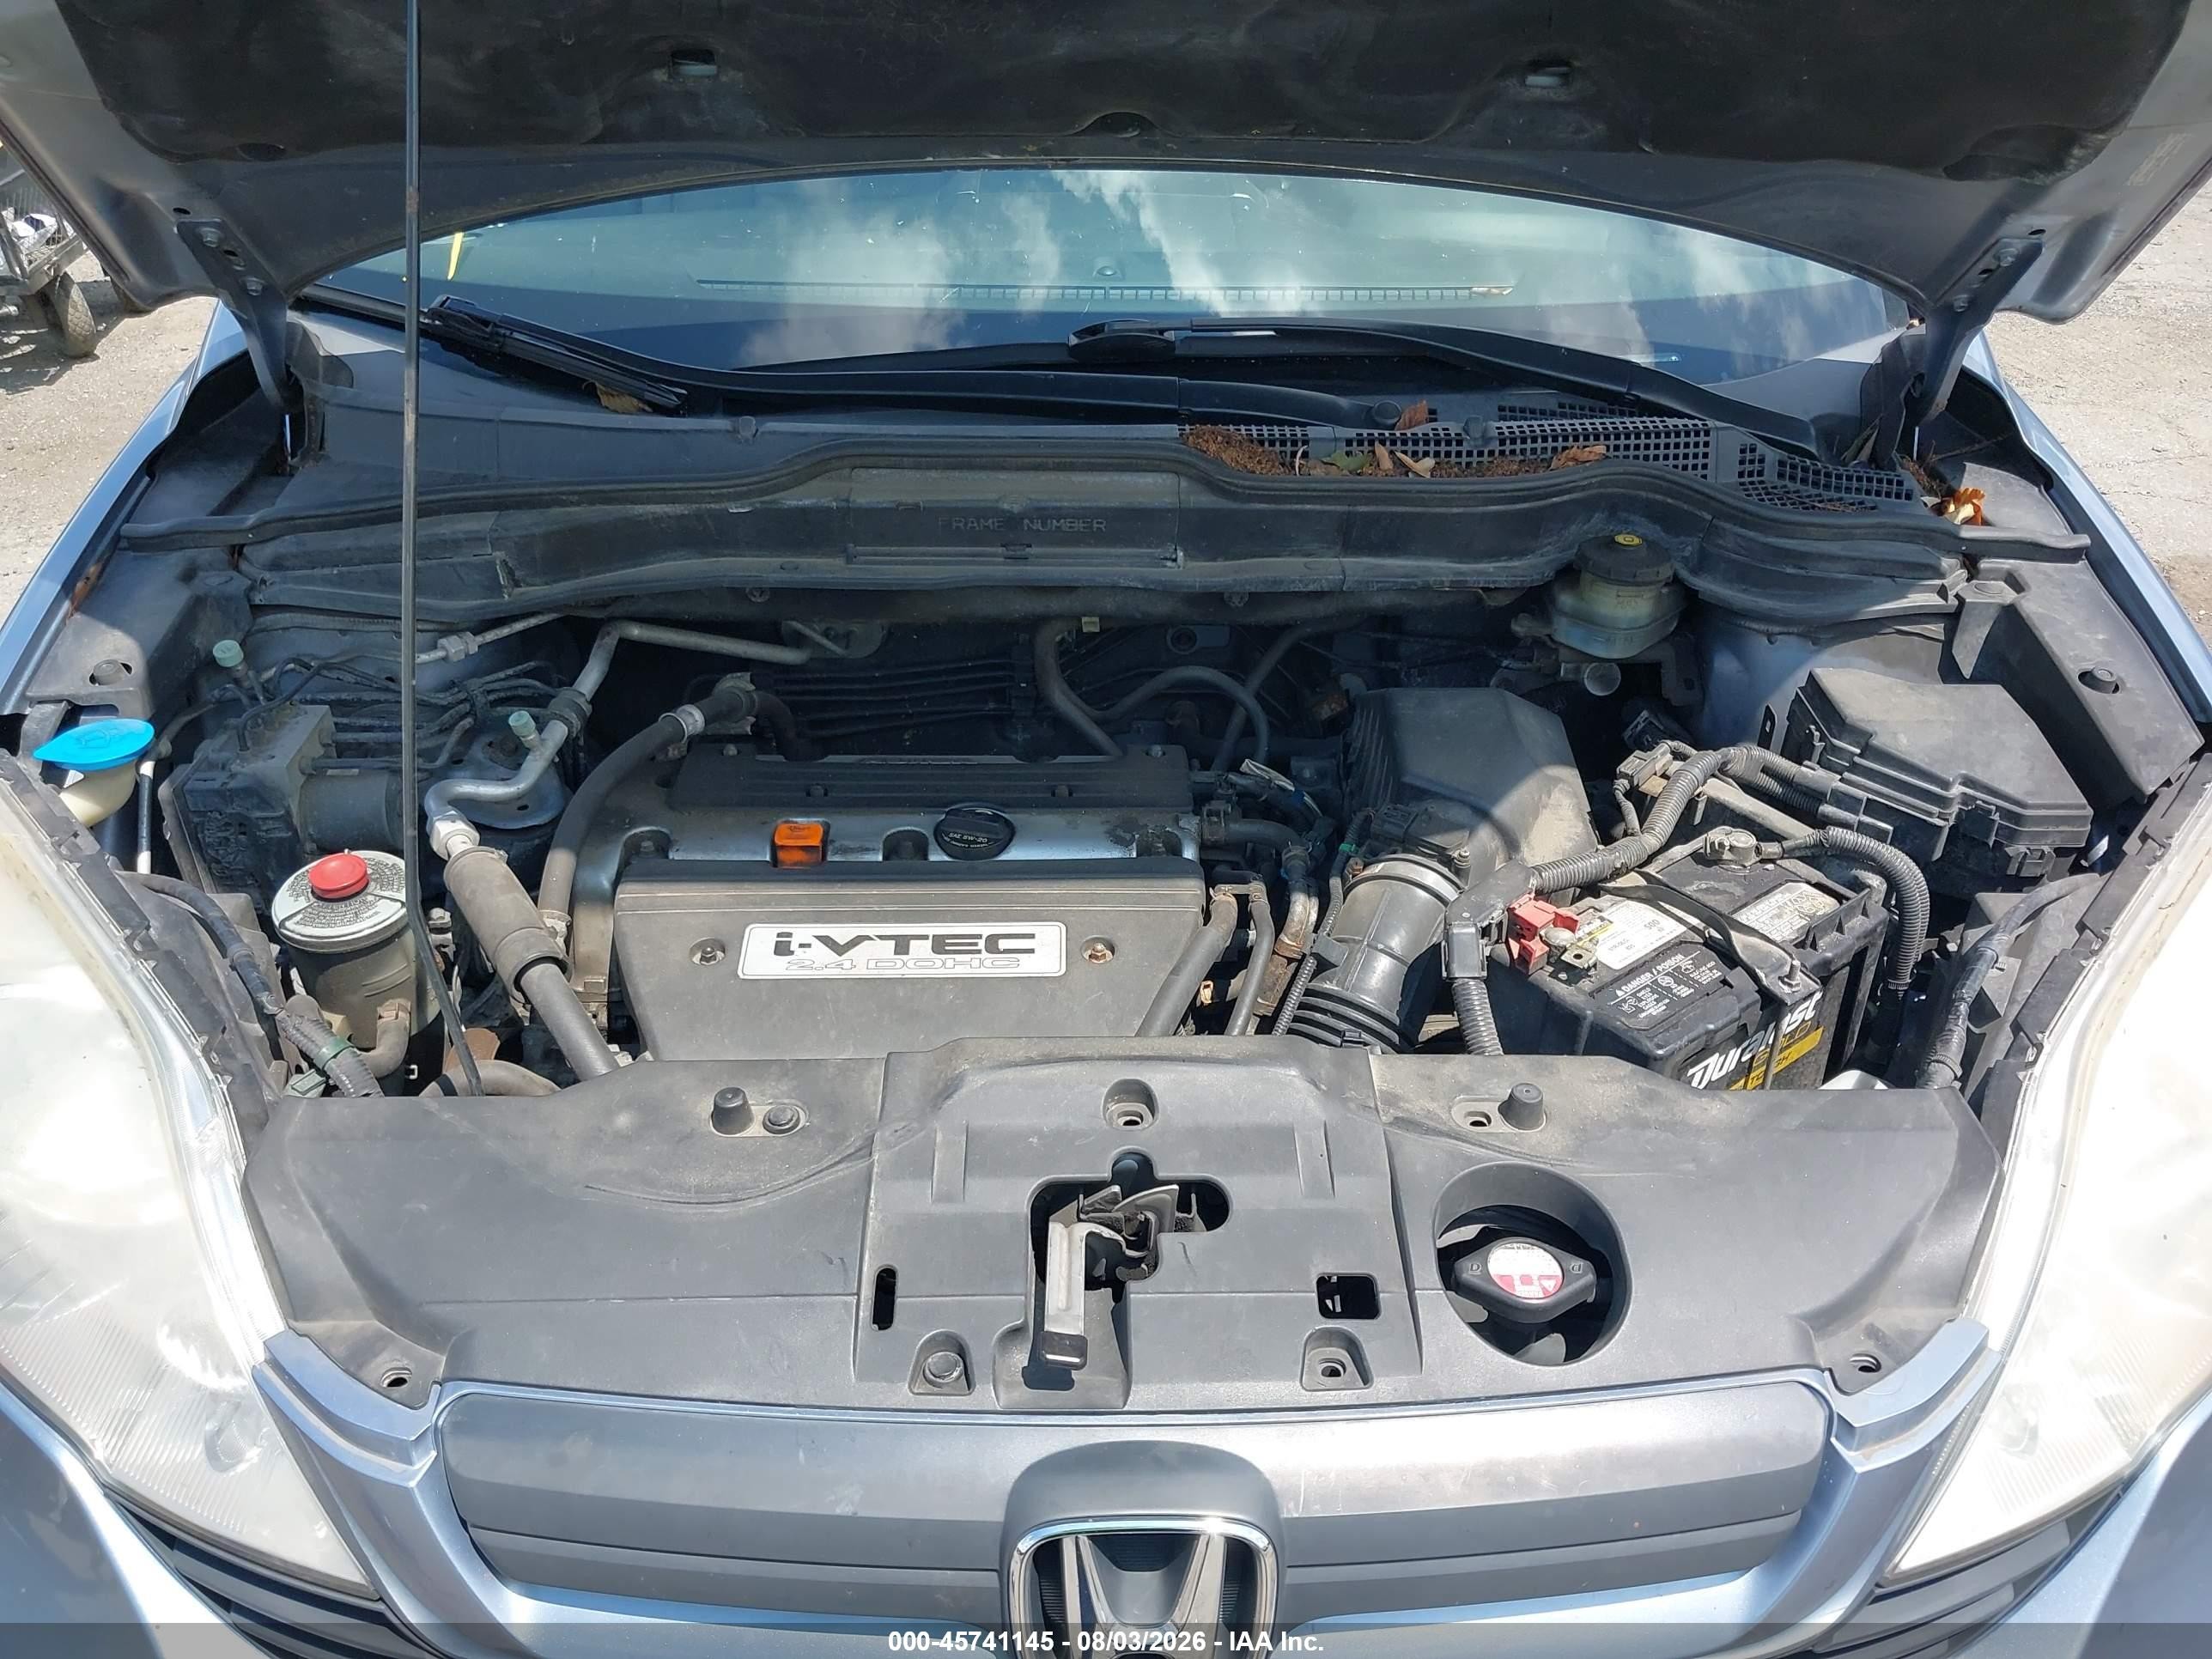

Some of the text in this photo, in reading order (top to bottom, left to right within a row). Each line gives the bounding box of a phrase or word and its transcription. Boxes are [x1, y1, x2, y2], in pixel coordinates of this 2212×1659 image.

[937, 517, 1108, 532] FRAME NUMBER
[963, 835, 988, 843] 5W-20
[773, 931, 1036, 957] i-VTEC
[785, 957, 1021, 971] 2.4 DOHC
[1621, 971, 1654, 993] DANGER
[1656, 953, 1686, 971] POISON
[1753, 1021, 1812, 1066] GLD
